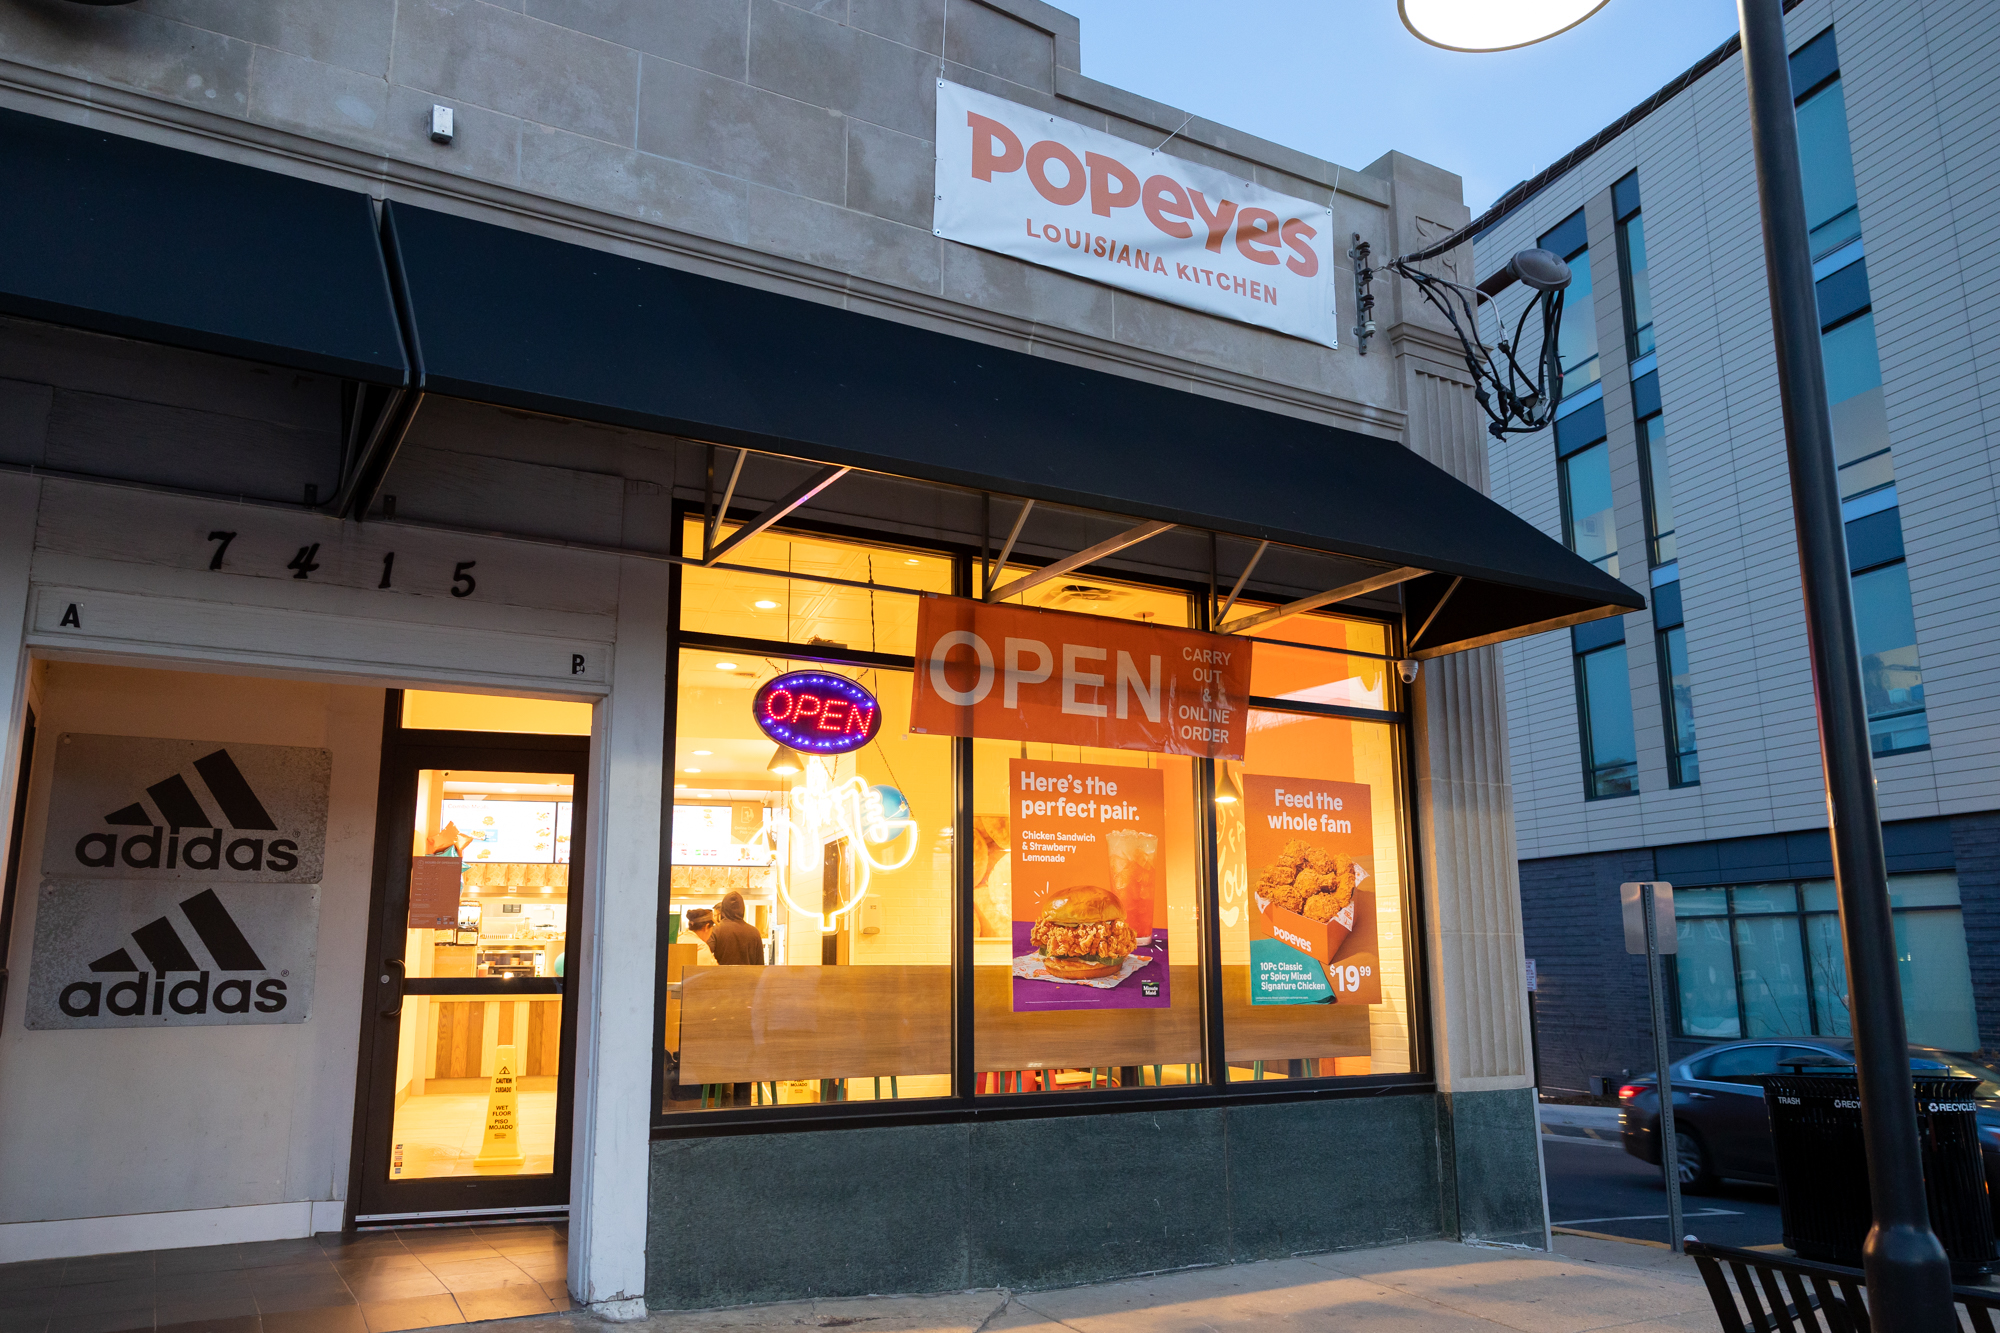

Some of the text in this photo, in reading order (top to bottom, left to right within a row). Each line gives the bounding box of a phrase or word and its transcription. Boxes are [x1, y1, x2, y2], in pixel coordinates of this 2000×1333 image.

[1026, 218, 1278, 307] LOUISIANA KITCHEN
[59, 603, 82, 629] A
[572, 653, 586, 675] B
[1182, 646, 1232, 667] CARRY
[929, 630, 1162, 724] OPEN
[1192, 667, 1223, 685] OUT
[1202, 688, 1212, 703] &
[765, 689, 874, 737] OPEN
[1178, 704, 1230, 725] ONLINE
[1181, 725, 1229, 744] ORDER
[1020, 771, 1118, 796] Here's the
[1021, 797, 1140, 823] perfect pair.
[1274, 788, 1343, 811] Feed the
[1267, 811, 1352, 834] whole fam
[1022, 830, 1096, 842] Chicken Sandwich
[75, 825, 299, 872] adidas
[1021, 842, 1077, 854] & Strawberry
[1022, 852, 1066, 863] Lemonade
[1260, 962, 1303, 971] 10Pc Classic
[1260, 972, 1312, 982] or Spicy Mixed
[58, 970, 288, 1018] adidas
[1261, 981, 1326, 992] Signature Chicken
[1777, 1096, 1801, 1106] TRASH
[1938, 1102, 1973, 1112] RECYCLE
